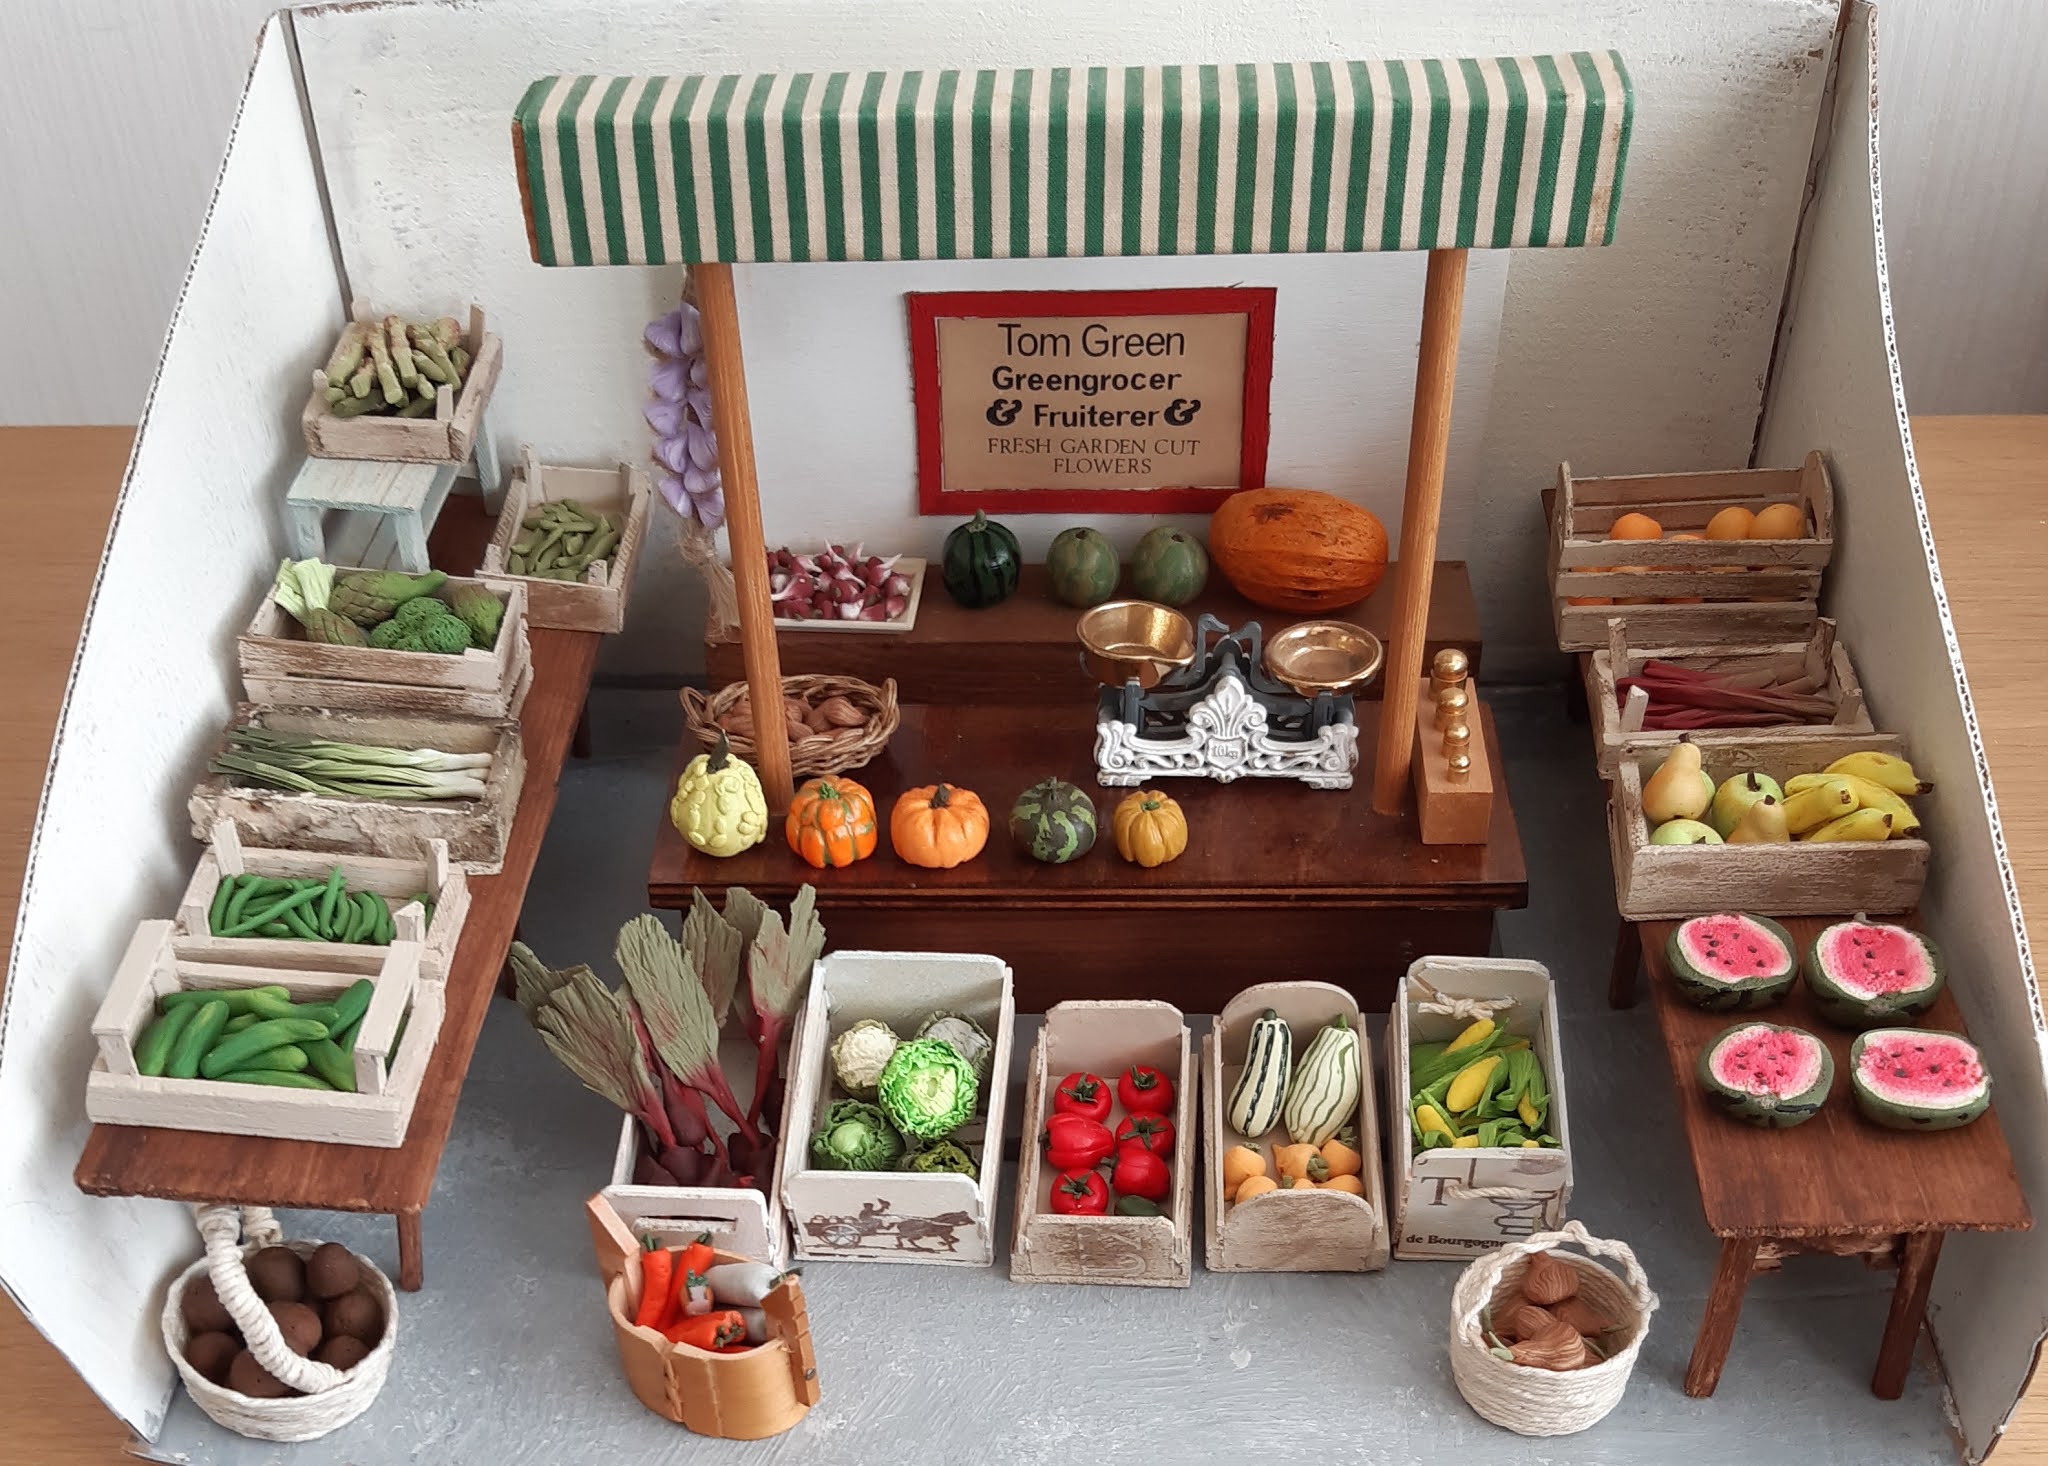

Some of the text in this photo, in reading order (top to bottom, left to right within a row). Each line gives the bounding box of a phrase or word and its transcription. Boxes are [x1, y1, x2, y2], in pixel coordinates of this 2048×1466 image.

[997, 322, 1185, 358] Tom Green
[992, 365, 1182, 396] Greengrocer
[986, 398, 1201, 428] & Fruiterer &
[988, 437, 1201, 455] FRESH GARDEN CUT
[1053, 458, 1152, 474] FLOWERS
[1406, 1234, 1424, 1244] de
